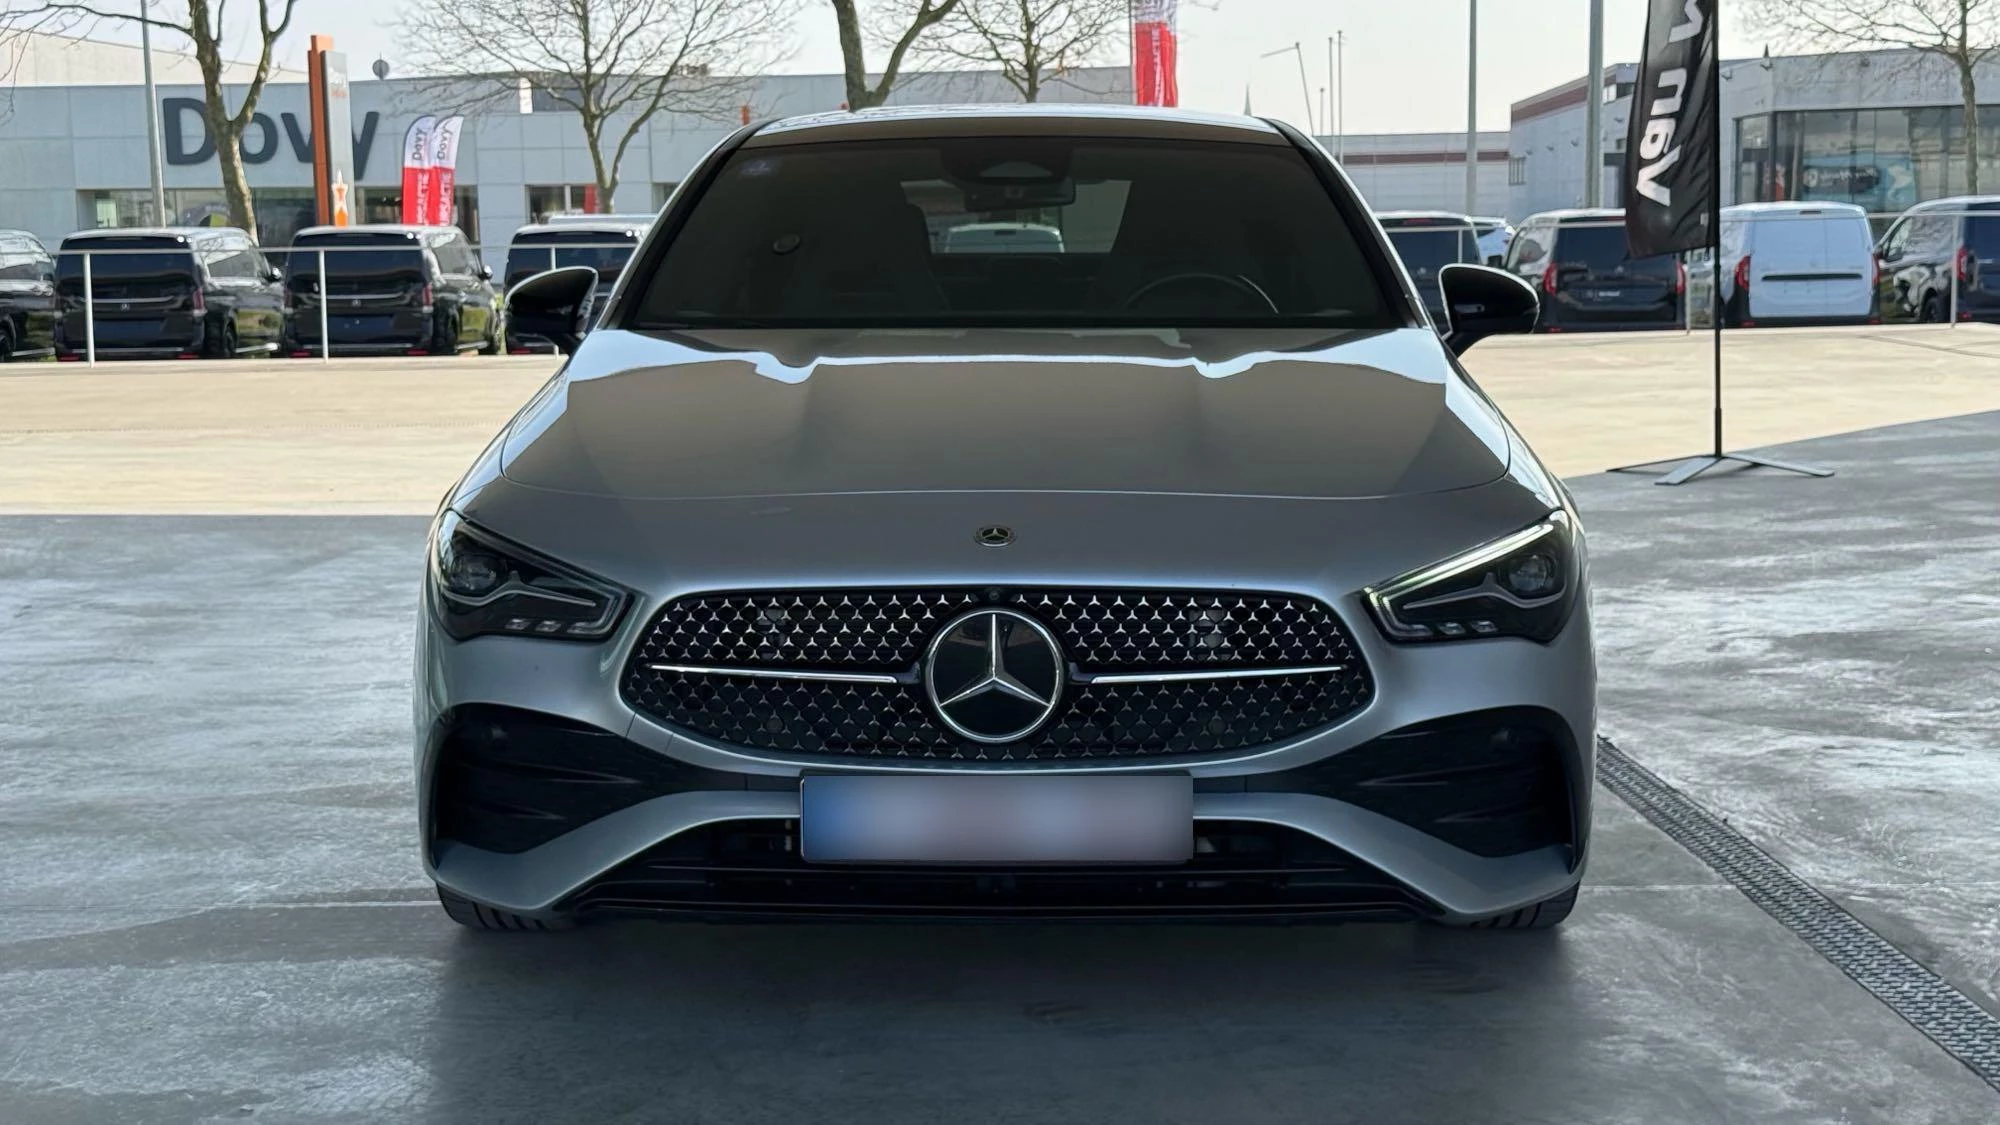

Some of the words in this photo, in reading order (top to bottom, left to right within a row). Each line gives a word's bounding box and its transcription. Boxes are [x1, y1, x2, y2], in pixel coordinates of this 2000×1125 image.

[162, 97, 380, 181] Dovy
[412, 127, 427, 161] Dovy
[436, 126, 453, 161] Dovy
